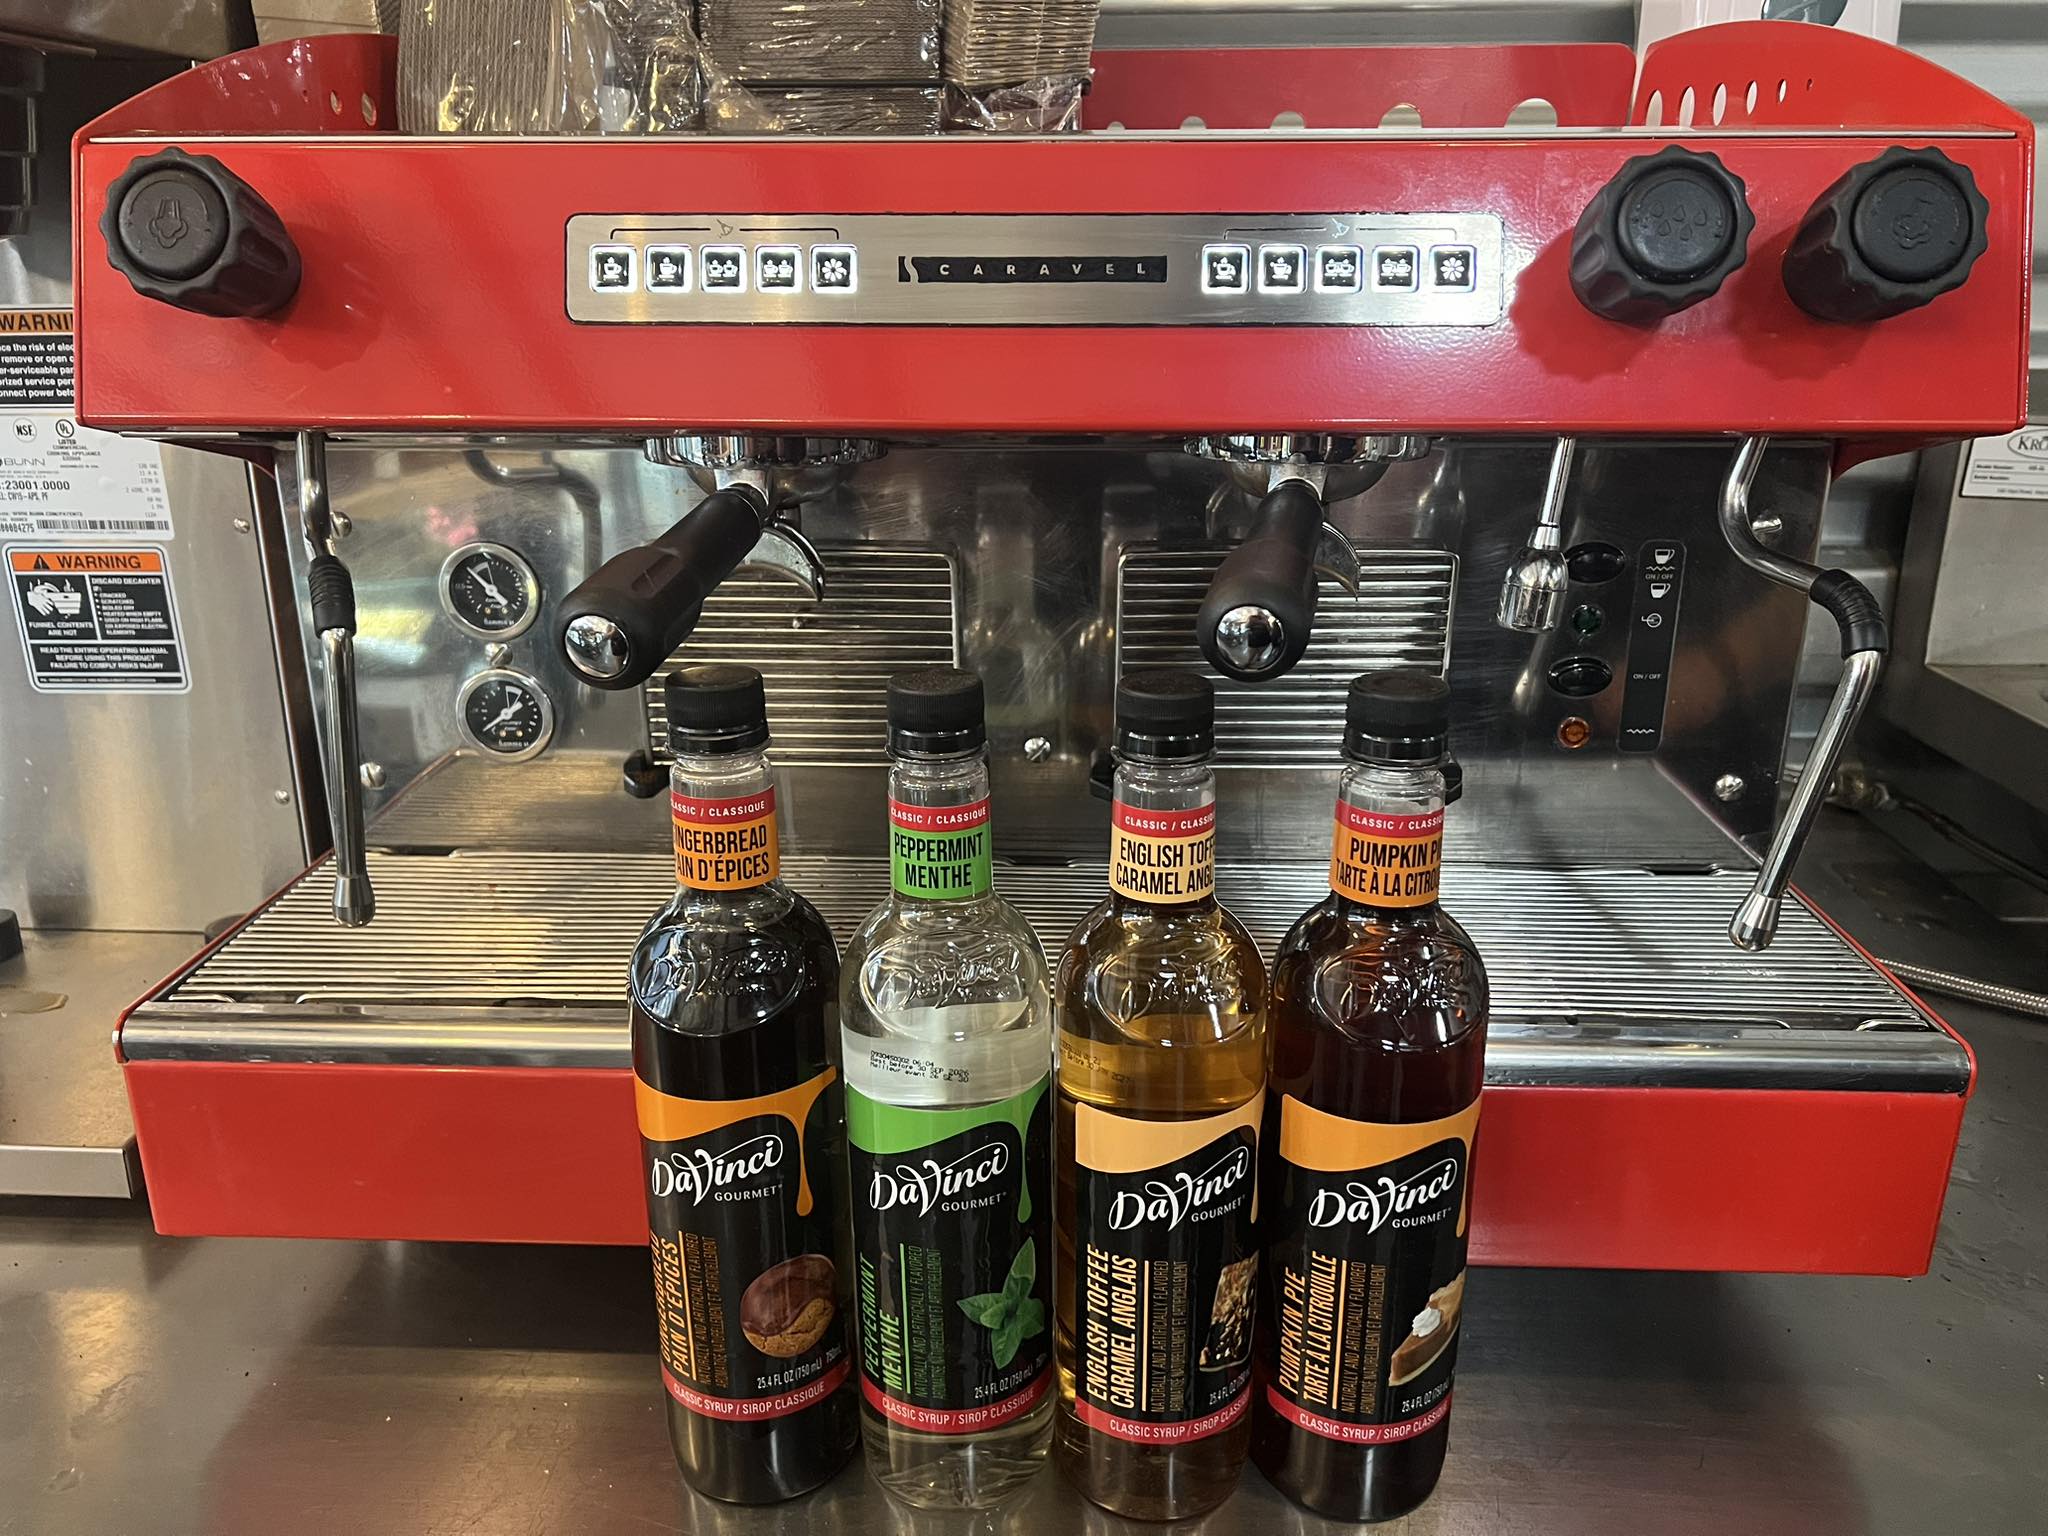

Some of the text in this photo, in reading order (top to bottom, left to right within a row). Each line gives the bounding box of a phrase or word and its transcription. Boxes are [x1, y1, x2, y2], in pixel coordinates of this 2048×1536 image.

[939, 263, 1146, 276] CARAVEL
[1, 355, 33, 364] remove
[34, 355, 44, 364] or
[45, 355, 68, 365] open
[12, 343, 27, 352] the
[28, 343, 46, 352] risk
[46, 343, 56, 352] of
[25, 377, 56, 386] service
[28, 390, 55, 399] power
[16, 424, 32, 436] NSF
[4, 457, 46, 466] BUNN
[56, 555, 142, 569] WARNING
[708, 800, 765, 817] CLASSIQUE
[890, 807, 923, 824] CLASSIC
[936, 806, 987, 825] CLASSIQUE
[1125, 815, 1167, 831] CLASSIC
[1350, 813, 1394, 830] CLASSIC
[894, 831, 984, 863] PEPPERMINT
[1120, 837, 1184, 869] ENGLISH
[1350, 836, 1428, 869] PUMPKIN
[698, 851, 769, 882] D'ÉPICES
[905, 862, 973, 890] MENTHE
[1116, 862, 1183, 895] CARAMEL
[1335, 858, 1368, 893] TARTE
[1369, 866, 1379, 895] À
[1383, 872, 1401, 897] LA
[652, 1134, 784, 1207] DaVinci
[869, 1141, 1009, 1218] DaVinci
[714, 1185, 778, 1202] GOURMET
[941, 1193, 1002, 1212] GOURMET
[1108, 1146, 1249, 1232] DaVinci
[1308, 1158, 1458, 1235] DaVinci
[1191, 1197, 1242, 1223] GOURMET
[1391, 1210, 1448, 1229] GOURMET
[908, 1245, 923, 1284] FLAVORED
[660, 1237, 690, 1378] PAIN D'ÉPICES
[859, 1251, 880, 1379] PEPPERMINT
[1086, 1243, 1109, 1401] ENGLISH TOFFEE
[1110, 1254, 1137, 1409] CARAMEL ANGLAIS
[1151, 1260, 1169, 1413] NATURALLY AND ARTIFICIALLY FLAVORED
[1279, 1266, 1306, 1395] PUMPKIN PIE
[1300, 1250, 1338, 1405] TARTE À LA CITROUILLE
[1341, 1260, 1367, 1413] NATURALLY AND ARTIFICIALLY FLAVORED
[879, 1309, 903, 1391] MENTHE
[756, 1375, 773, 1390] 25.4
[773, 1373, 783, 1386] FL
[783, 1369, 795, 1384] OZ
[990, 1382, 999, 1395] FL
[999, 1377, 1009, 1391] OZ
[673, 1382, 703, 1409] CLASSIC
[704, 1400, 734, 1415] SYRUP
[742, 1401, 772, 1414] SIROP
[775, 1380, 826, 1410] CLASSIQUE
[882, 1397, 917, 1421] CLASSIC
[918, 1411, 950, 1426] SYRUP
[958, 1410, 988, 1425] SIROP
[990, 1389, 1035, 1418] CLASSIQUE
[1423, 1390, 1432, 1405] OZ
[1110, 1419, 1150, 1438] CLASSIC
[1153, 1426, 1185, 1438] SYRUP
[1193, 1415, 1220, 1434] SIROP
[1300, 1413, 1340, 1437] CLASSIC
[1342, 1427, 1376, 1440] SYRUP
[1383, 1424, 1411, 1440] SIROP
